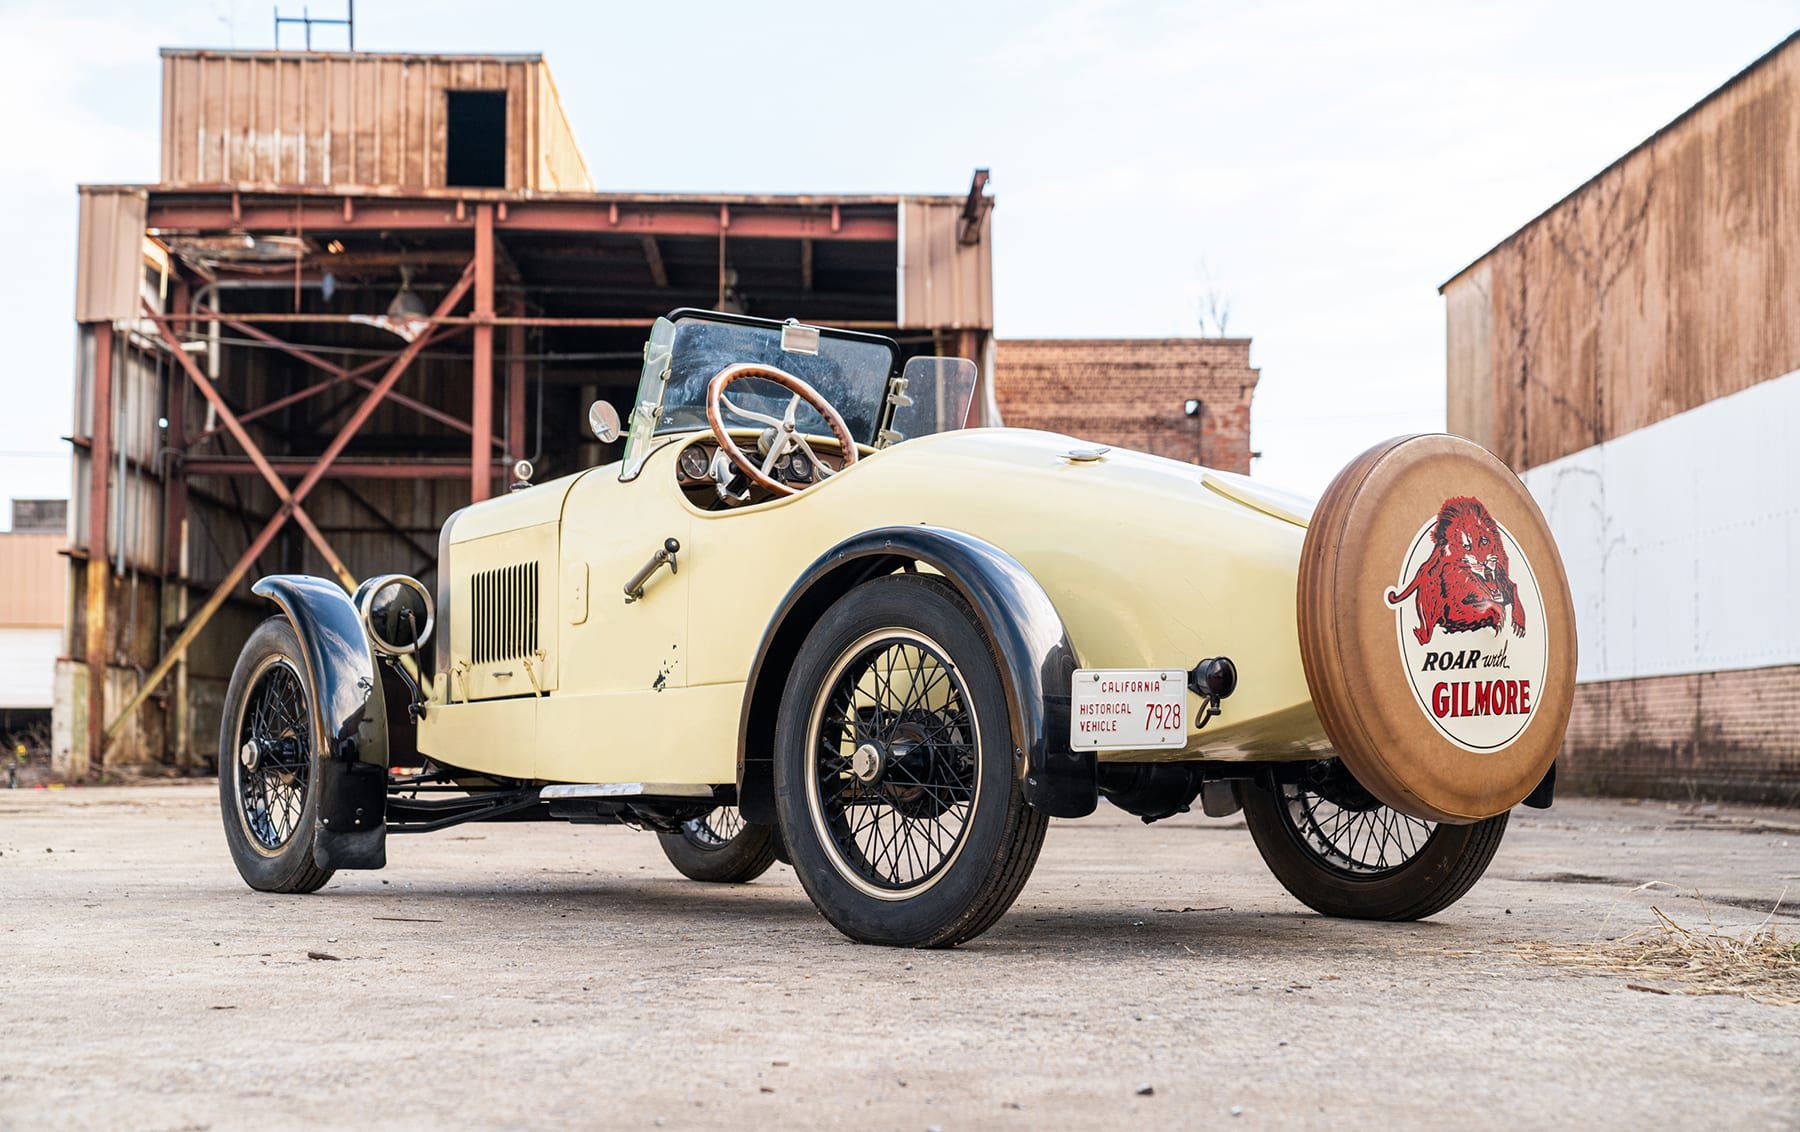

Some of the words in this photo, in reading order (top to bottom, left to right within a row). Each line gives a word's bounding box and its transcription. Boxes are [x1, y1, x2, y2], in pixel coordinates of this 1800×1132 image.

[1421, 650, 1481, 671] ROAR
[1482, 639, 1510, 669] with
[1101, 681, 1160, 693] CALIFORNIA
[1432, 679, 1531, 718] GILMORE
[1080, 703, 1132, 715] HISTORICAL
[1145, 703, 1181, 731] 7928
[1080, 720, 1117, 732] VEHICLE
